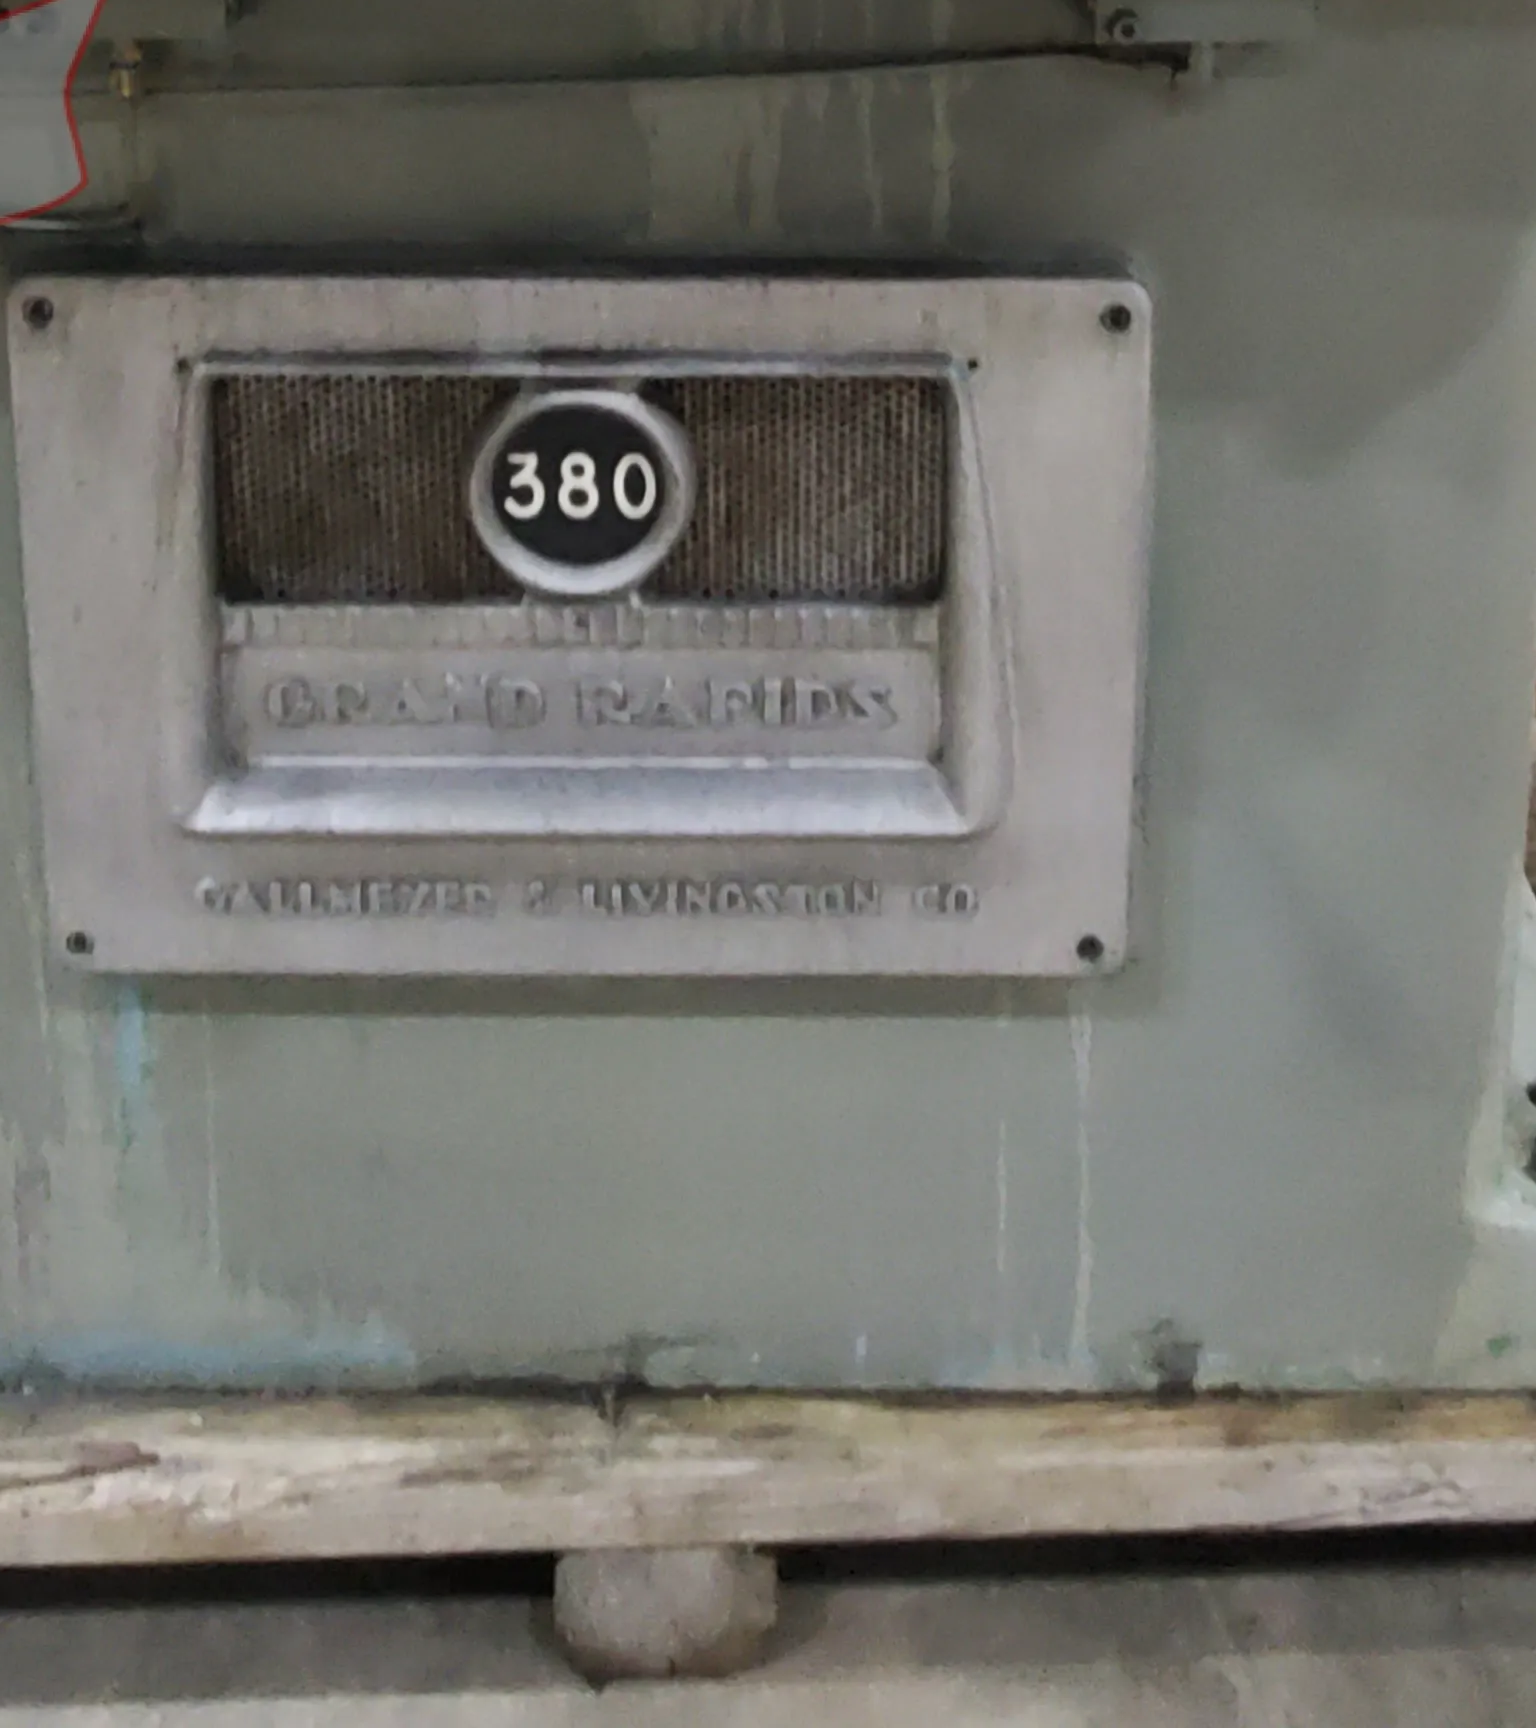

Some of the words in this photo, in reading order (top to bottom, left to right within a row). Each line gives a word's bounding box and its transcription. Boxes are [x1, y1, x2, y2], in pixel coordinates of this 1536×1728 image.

[503, 450, 657, 520] 380
[265, 673, 547, 730] GRAND
[574, 673, 900, 732] RAPIDS
[578, 879, 881, 917] LIVINGSTON
